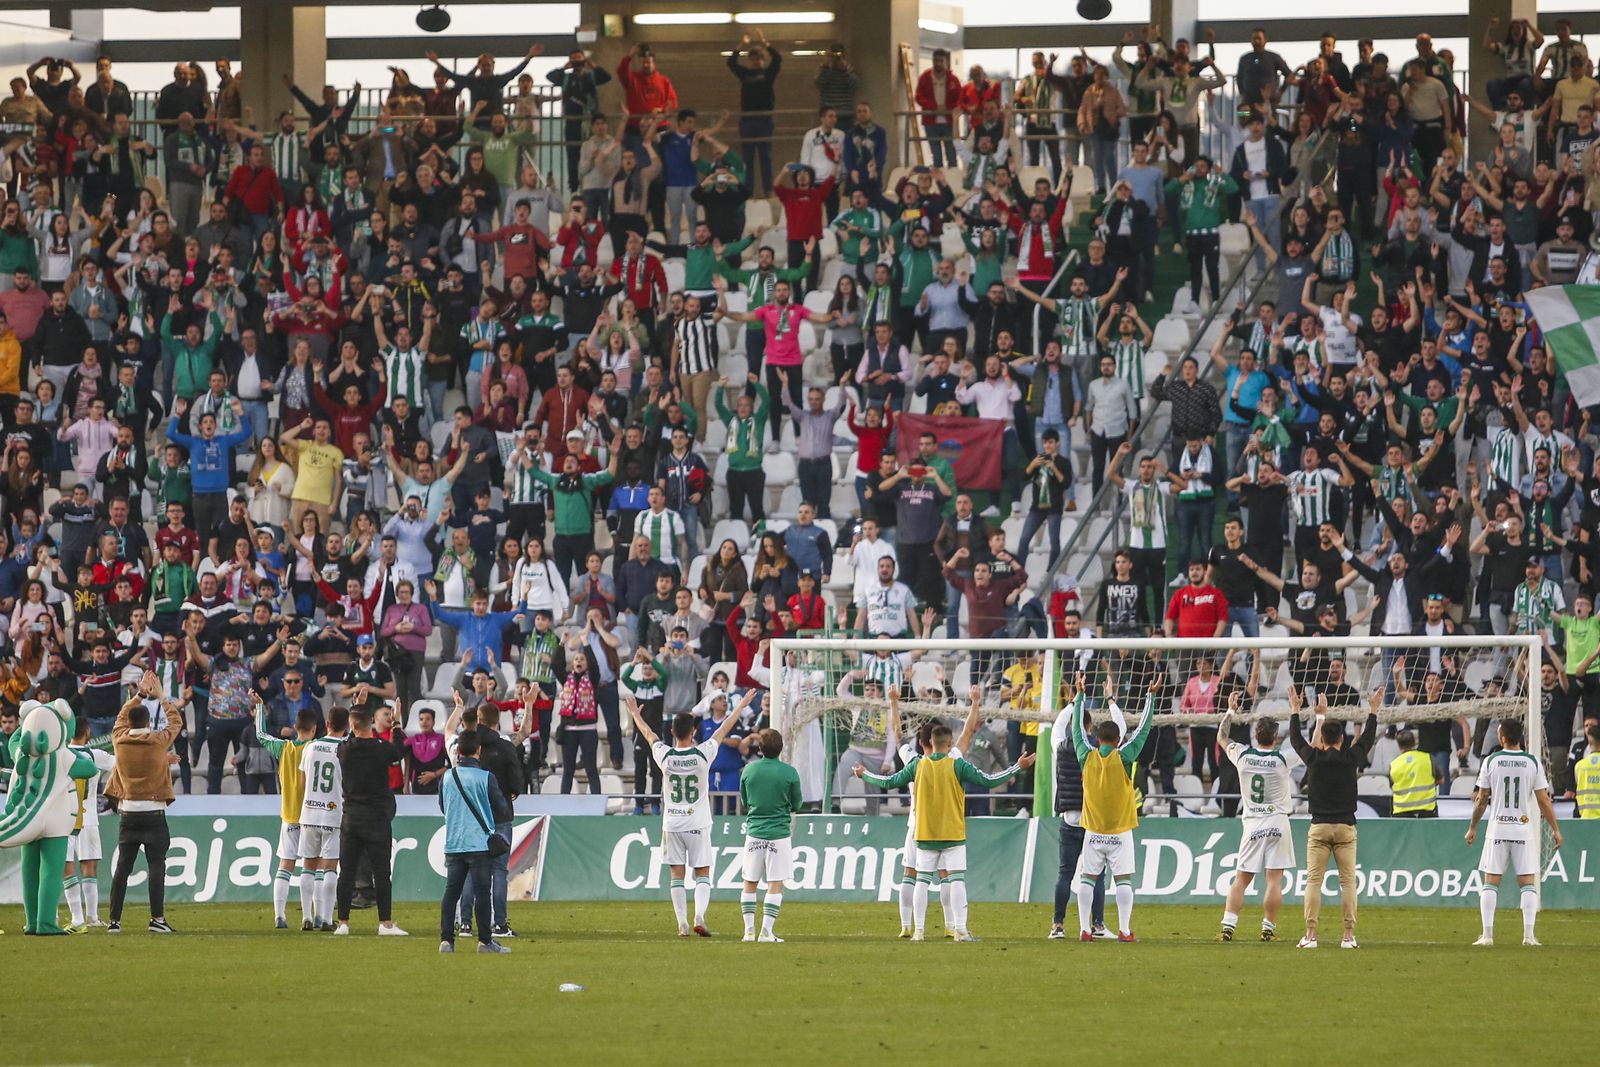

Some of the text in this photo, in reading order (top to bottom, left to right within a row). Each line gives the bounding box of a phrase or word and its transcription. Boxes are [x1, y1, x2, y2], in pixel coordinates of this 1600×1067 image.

[1107, 585, 1137, 597] INNER
[673, 759, 698, 767] NAVARRO
[1498, 760, 1528, 768] MOUTINHO
[312, 761, 335, 793] 19
[669, 774, 699, 804] 36
[1250, 774, 1265, 804] 9
[1503, 776, 1520, 809] 11
[808, 822, 869, 836] 1904
[1496, 815, 1518, 823] PIEDRA
[1134, 832, 1258, 896] Día
